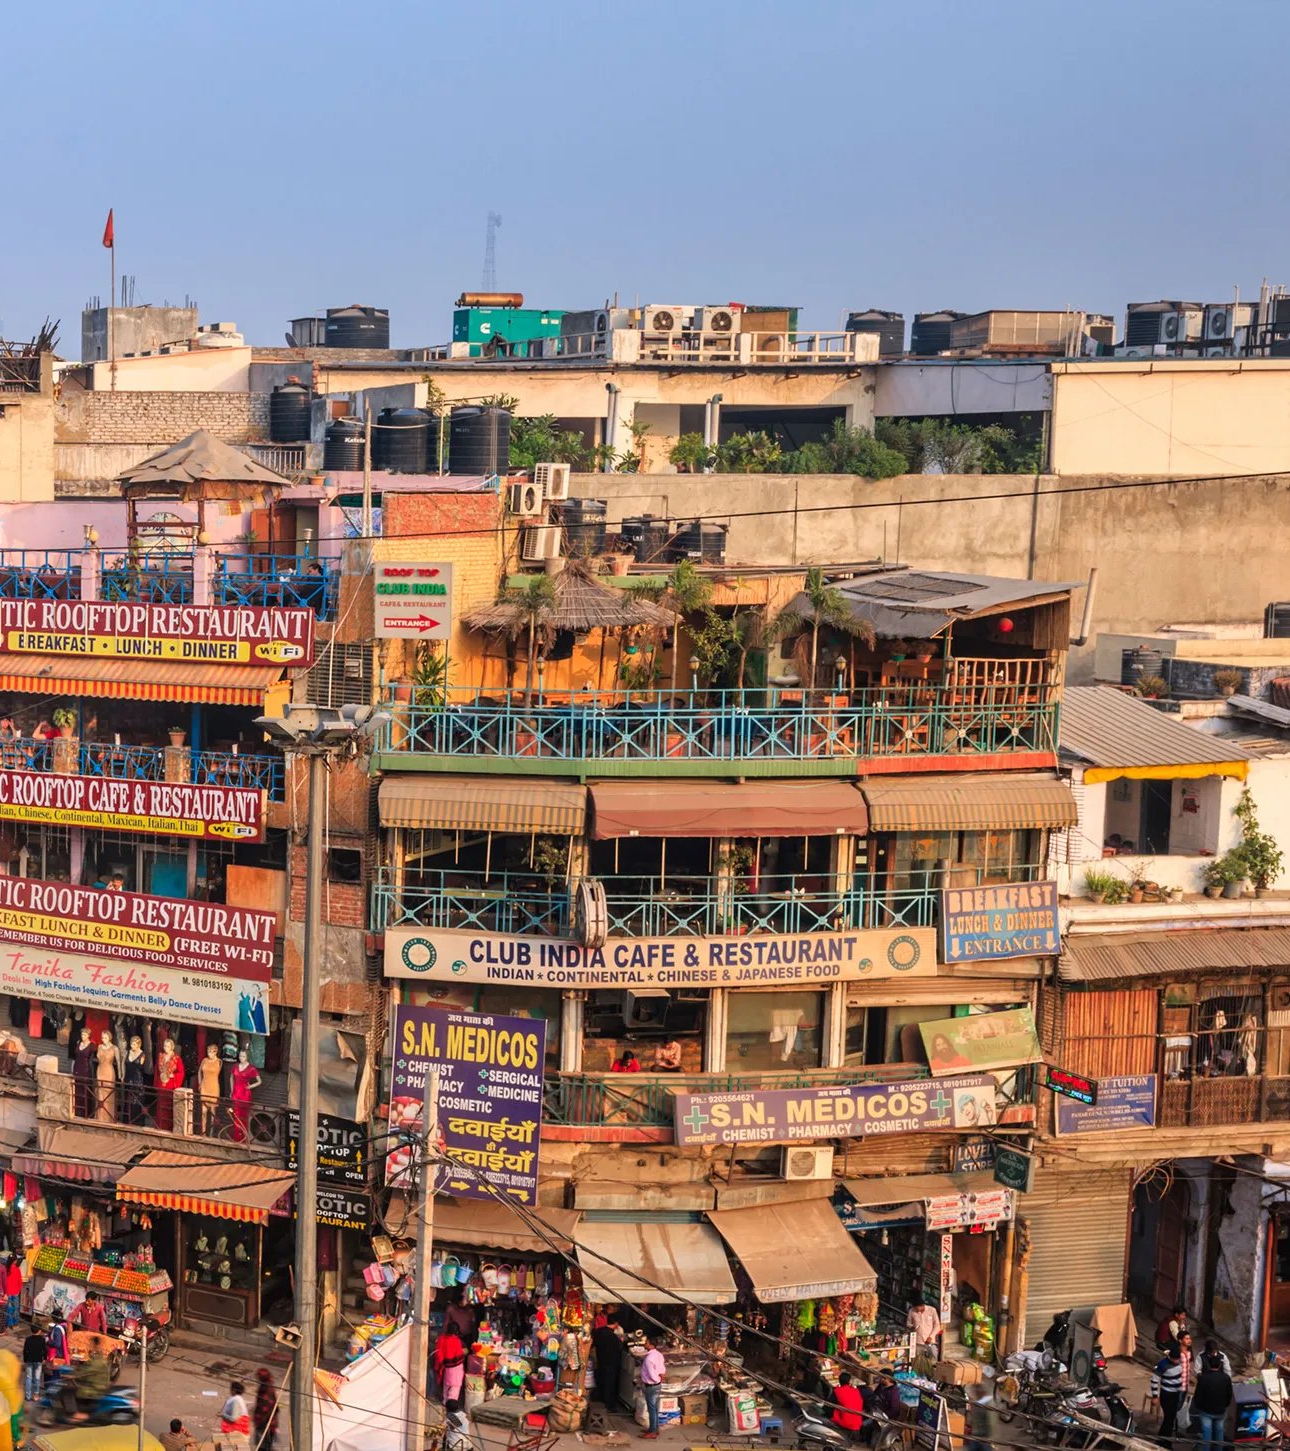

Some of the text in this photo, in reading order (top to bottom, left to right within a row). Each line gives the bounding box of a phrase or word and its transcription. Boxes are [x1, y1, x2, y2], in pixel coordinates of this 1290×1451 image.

[384, 568, 440, 577] ROOF TOP
[377, 583, 447, 595] CLUB INDIA
[41, 602, 146, 633] ROOFTOP
[152, 606, 308, 639] RESTAURANT
[18, 634, 238, 659] BREAKFAST LUNCH DINNER
[12, 775, 85, 809] ROOFTOP
[89, 781, 130, 813] CAFE
[133, 784, 146, 815] &
[150, 785, 259, 823] RESTAURANT
[54, 810, 105, 824] Continental,
[949, 885, 1053, 913] BREAKFAST
[29, 884, 127, 921] ROOFTOP
[131, 898, 276, 943] RESTAURANT
[40, 918, 88, 936] LUNCH
[93, 926, 104, 938] &
[108, 928, 166, 948] DINNER
[949, 911, 1055, 936] LUNCH & DINNER
[49, 937, 63, 947] US
[64, 940, 85, 951] FOR
[87, 943, 143, 960] DELICIOUS
[145, 951, 175, 964] FOOD
[177, 956, 228, 972] SERVICES
[470, 937, 857, 968] CLUB INDIA CAFE & RESTAURANT
[965, 936, 1042, 955] ENTRANCE
[6, 952, 170, 994] Tanika Fashion
[487, 965, 840, 983] INDIAN CONTINENTAL CHINESE & JAPANESE FOOD
[192, 977, 233, 992] 9810183192
[35, 978, 52, 989] High
[54, 981, 80, 992] Fashion
[83, 985, 109, 998] Sequins
[111, 990, 146, 1003] Garments
[148, 995, 167, 1007] Belly
[169, 999, 192, 1010] Dance
[194, 1002, 222, 1015] Dresses
[402, 1020, 538, 1069] S.N. MEDICOS
[408, 1060, 454, 1076] CHEMIST
[407, 1076, 464, 1093] PHAMACY
[489, 1070, 541, 1087] SERGICAL
[1113, 1077, 1148, 1087] TUITION
[488, 1086, 539, 1102] MEDICINE
[708, 1094, 754, 1104] 9205564621
[439, 1096, 492, 1113] COSMETIC
[710, 1092, 928, 1127] S.N. MEDICOS
[722, 1118, 919, 1141] CHEMIST PHARMACY COSMETIC
[345, 1172, 364, 1180] OPEN
[317, 1209, 349, 1219] OOFTOP
